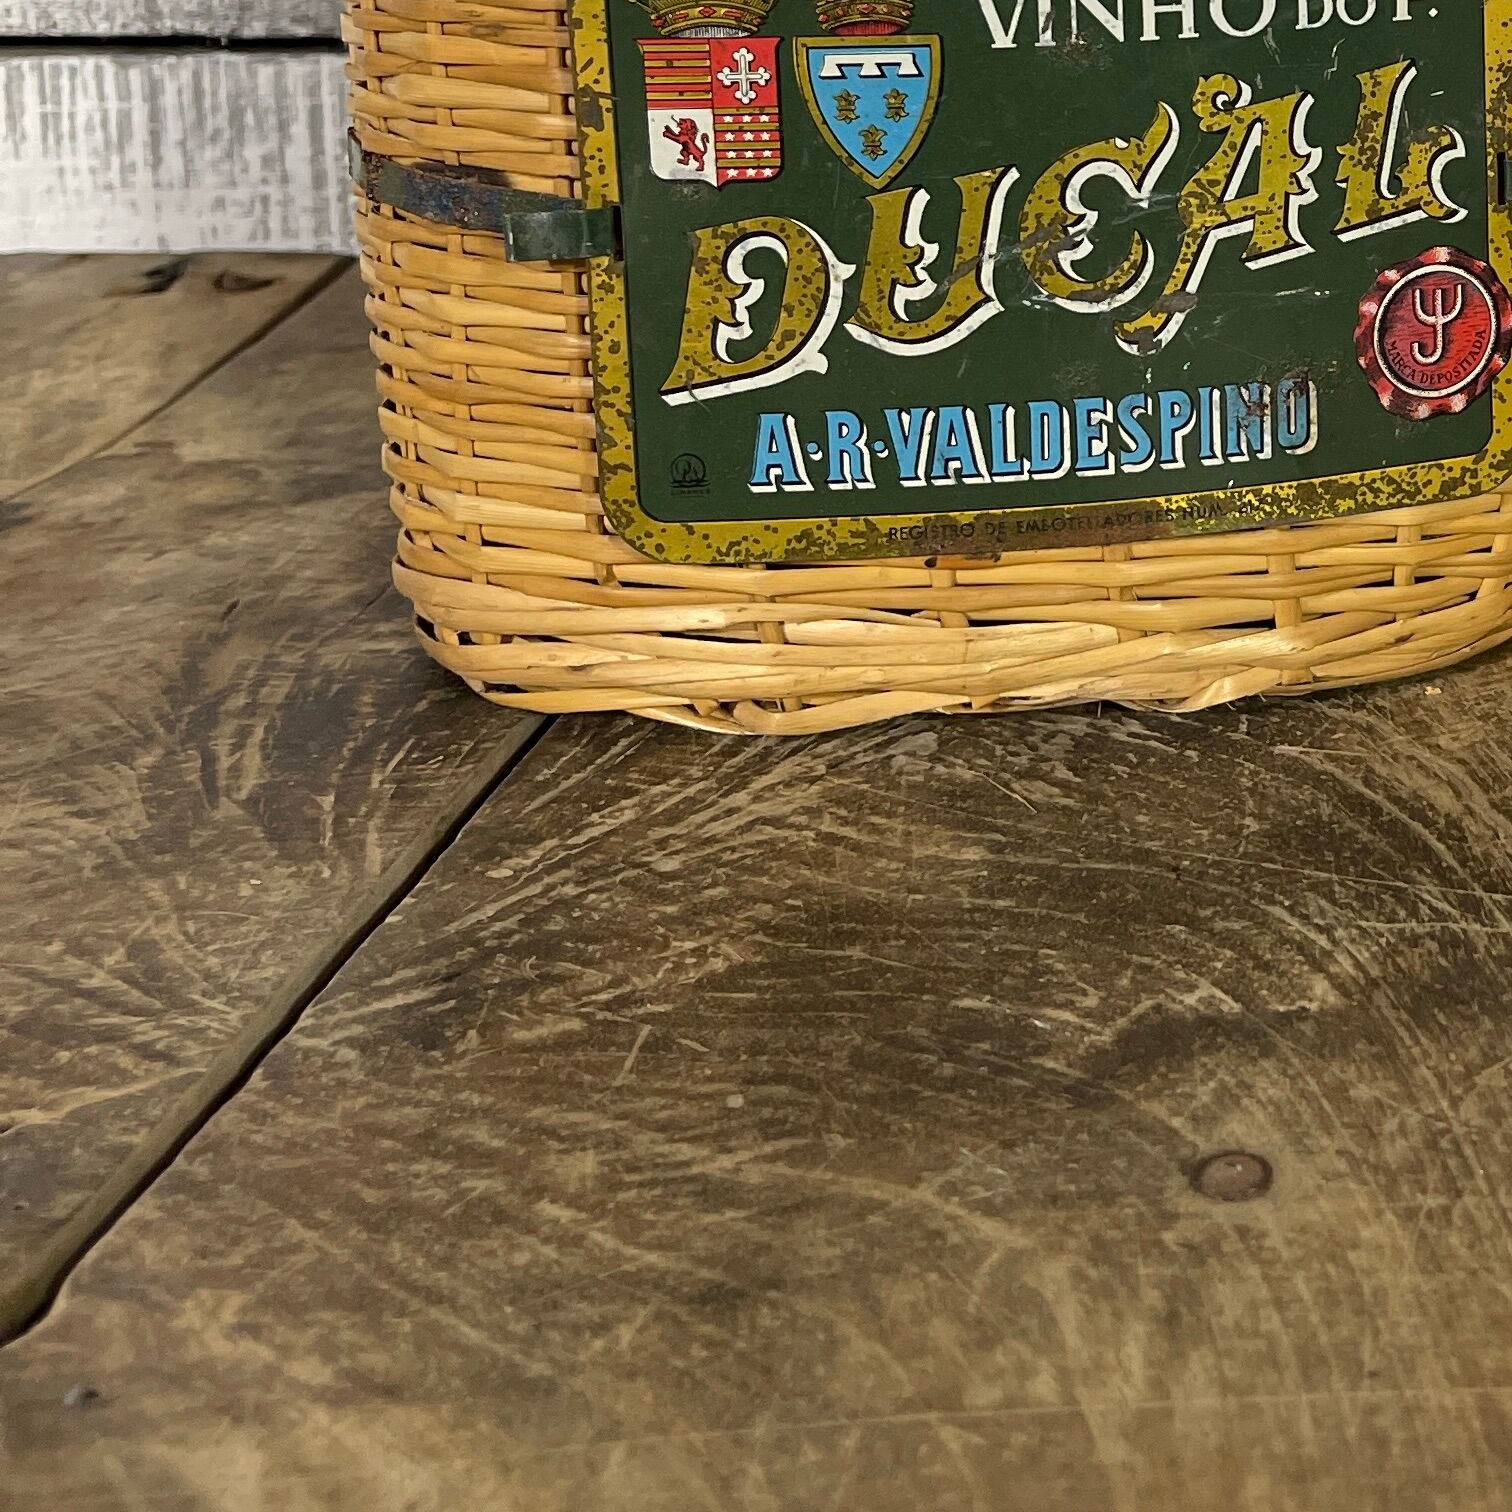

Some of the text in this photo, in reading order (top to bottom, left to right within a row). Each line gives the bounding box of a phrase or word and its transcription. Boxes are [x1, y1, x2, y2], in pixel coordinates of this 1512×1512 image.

[660, 58, 1468, 406] DUCAL
[1387, 329, 1487, 385] MARCA DEPOSITADA
[887, 522, 975, 542] REGISTRO
[985, 521, 1006, 536] DE
